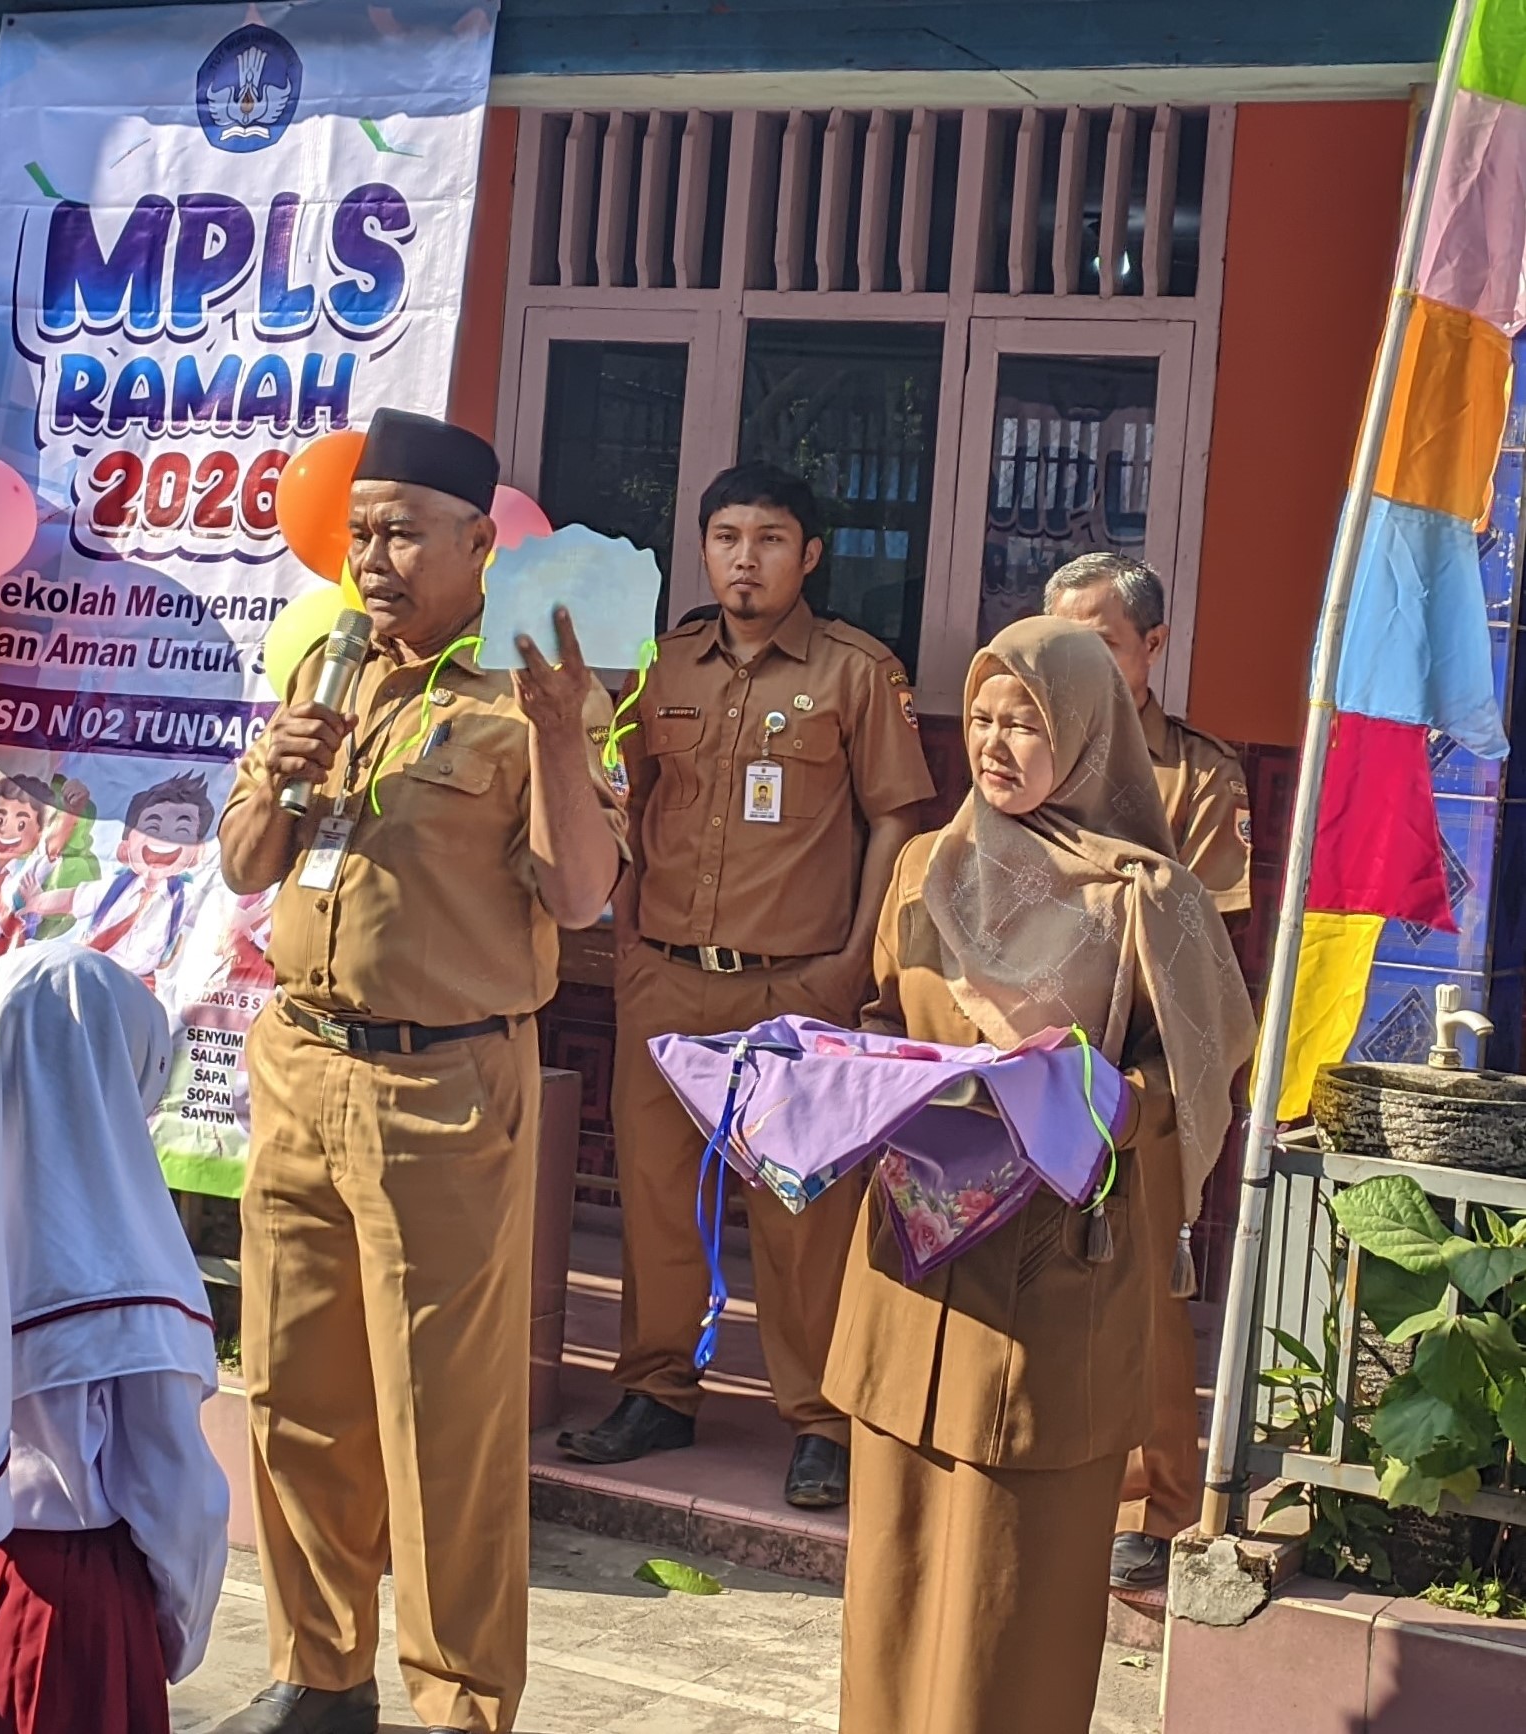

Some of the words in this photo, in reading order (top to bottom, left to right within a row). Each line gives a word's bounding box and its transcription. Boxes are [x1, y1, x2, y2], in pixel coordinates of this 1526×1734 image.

[39, 182, 418, 338] MPLS
[52, 351, 359, 436] RAMAH
[89, 449, 280, 538] 2026
[45, 633, 136, 668] Aman
[148, 637, 242, 673] Untuk
[48, 704, 75, 738] N
[80, 706, 125, 741] 02
[184, 991, 234, 1006] DAYA
[239, 996, 248, 1008] 5
[251, 998, 261, 1010] S
[187, 1028, 244, 1048] SENYUM
[191, 1049, 236, 1066] SALAM
[194, 1068, 227, 1086] SAPA
[187, 1087, 231, 1105] SOPAN
[181, 1106, 235, 1125] SANTUN
